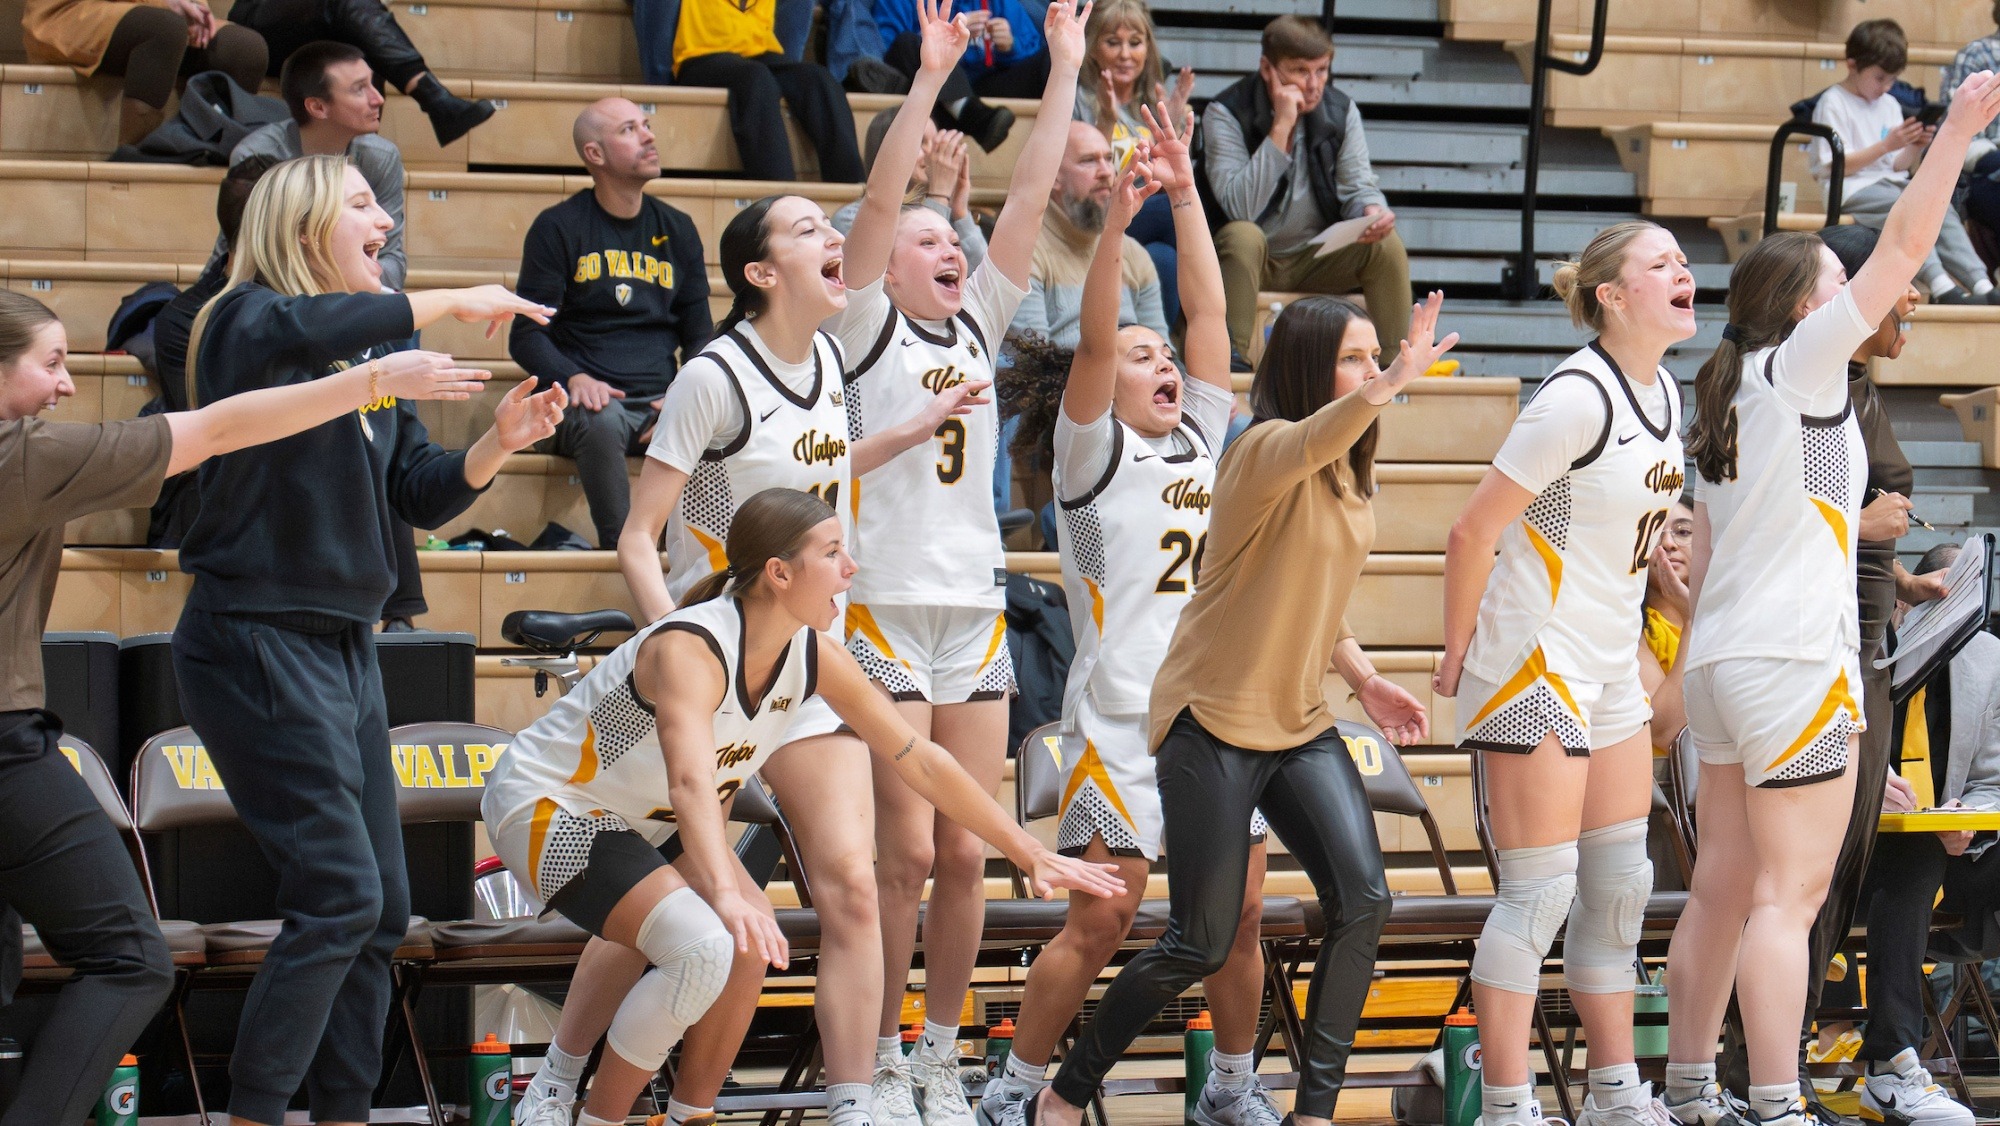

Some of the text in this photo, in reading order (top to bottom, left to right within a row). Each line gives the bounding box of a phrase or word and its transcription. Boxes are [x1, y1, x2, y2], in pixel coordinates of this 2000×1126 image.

[604, 249, 674, 290] VALPO
[793, 427, 847, 467] Valpo
[934, 416, 967, 486] 3
[1160, 477, 1212, 516] Valp
[150, 571, 162, 581] 10
[510, 572, 520, 582] 12
[1427, 776, 1438, 786] 16
[110, 1085, 135, 1116] G
[486, 1071, 510, 1101] G
